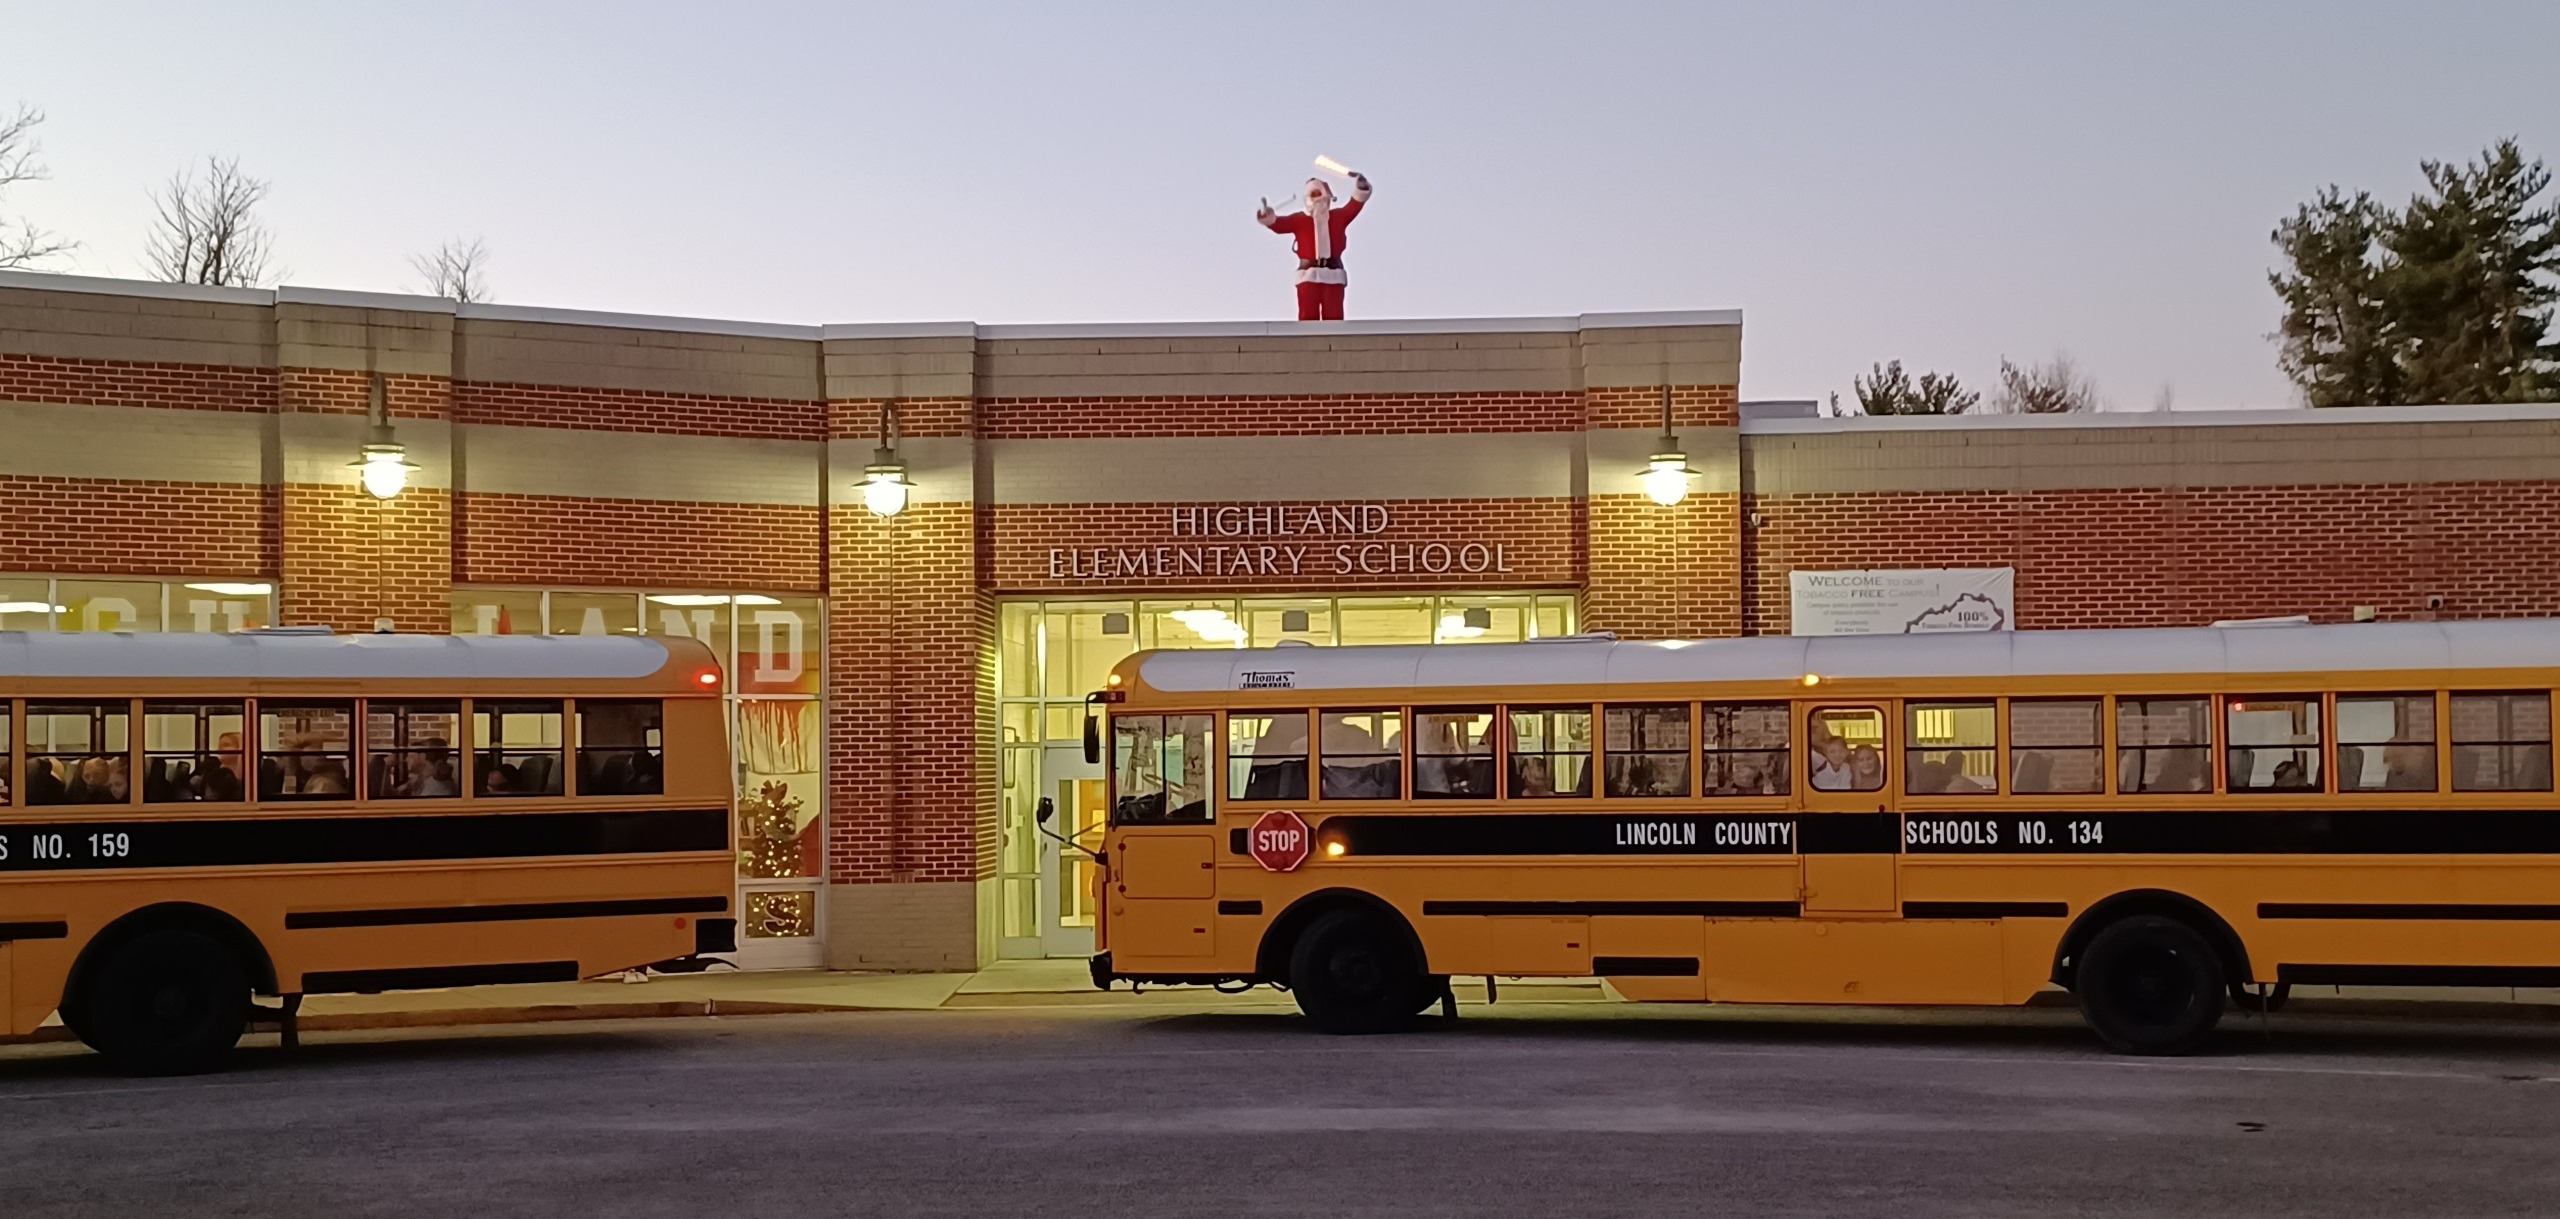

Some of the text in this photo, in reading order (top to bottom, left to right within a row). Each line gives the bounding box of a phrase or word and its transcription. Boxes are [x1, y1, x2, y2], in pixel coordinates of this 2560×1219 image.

[1172, 504, 1389, 536] HIGHLAND
[1049, 542, 1514, 579] ELEMENTARY SCHOOL
[1808, 575, 1883, 587] WELCOME
[1851, 589, 1884, 598] FREE
[1958, 611, 1989, 622] 100%
[1241, 671, 1295, 683] Thomas
[1258, 829, 1300, 852] STOP
[1616, 822, 1791, 846] LINCOLN COUNTY
[1906, 820, 2104, 844] SCHOOLS NO. 134
[33, 834, 71, 859] NO.
[88, 832, 130, 857] 159
